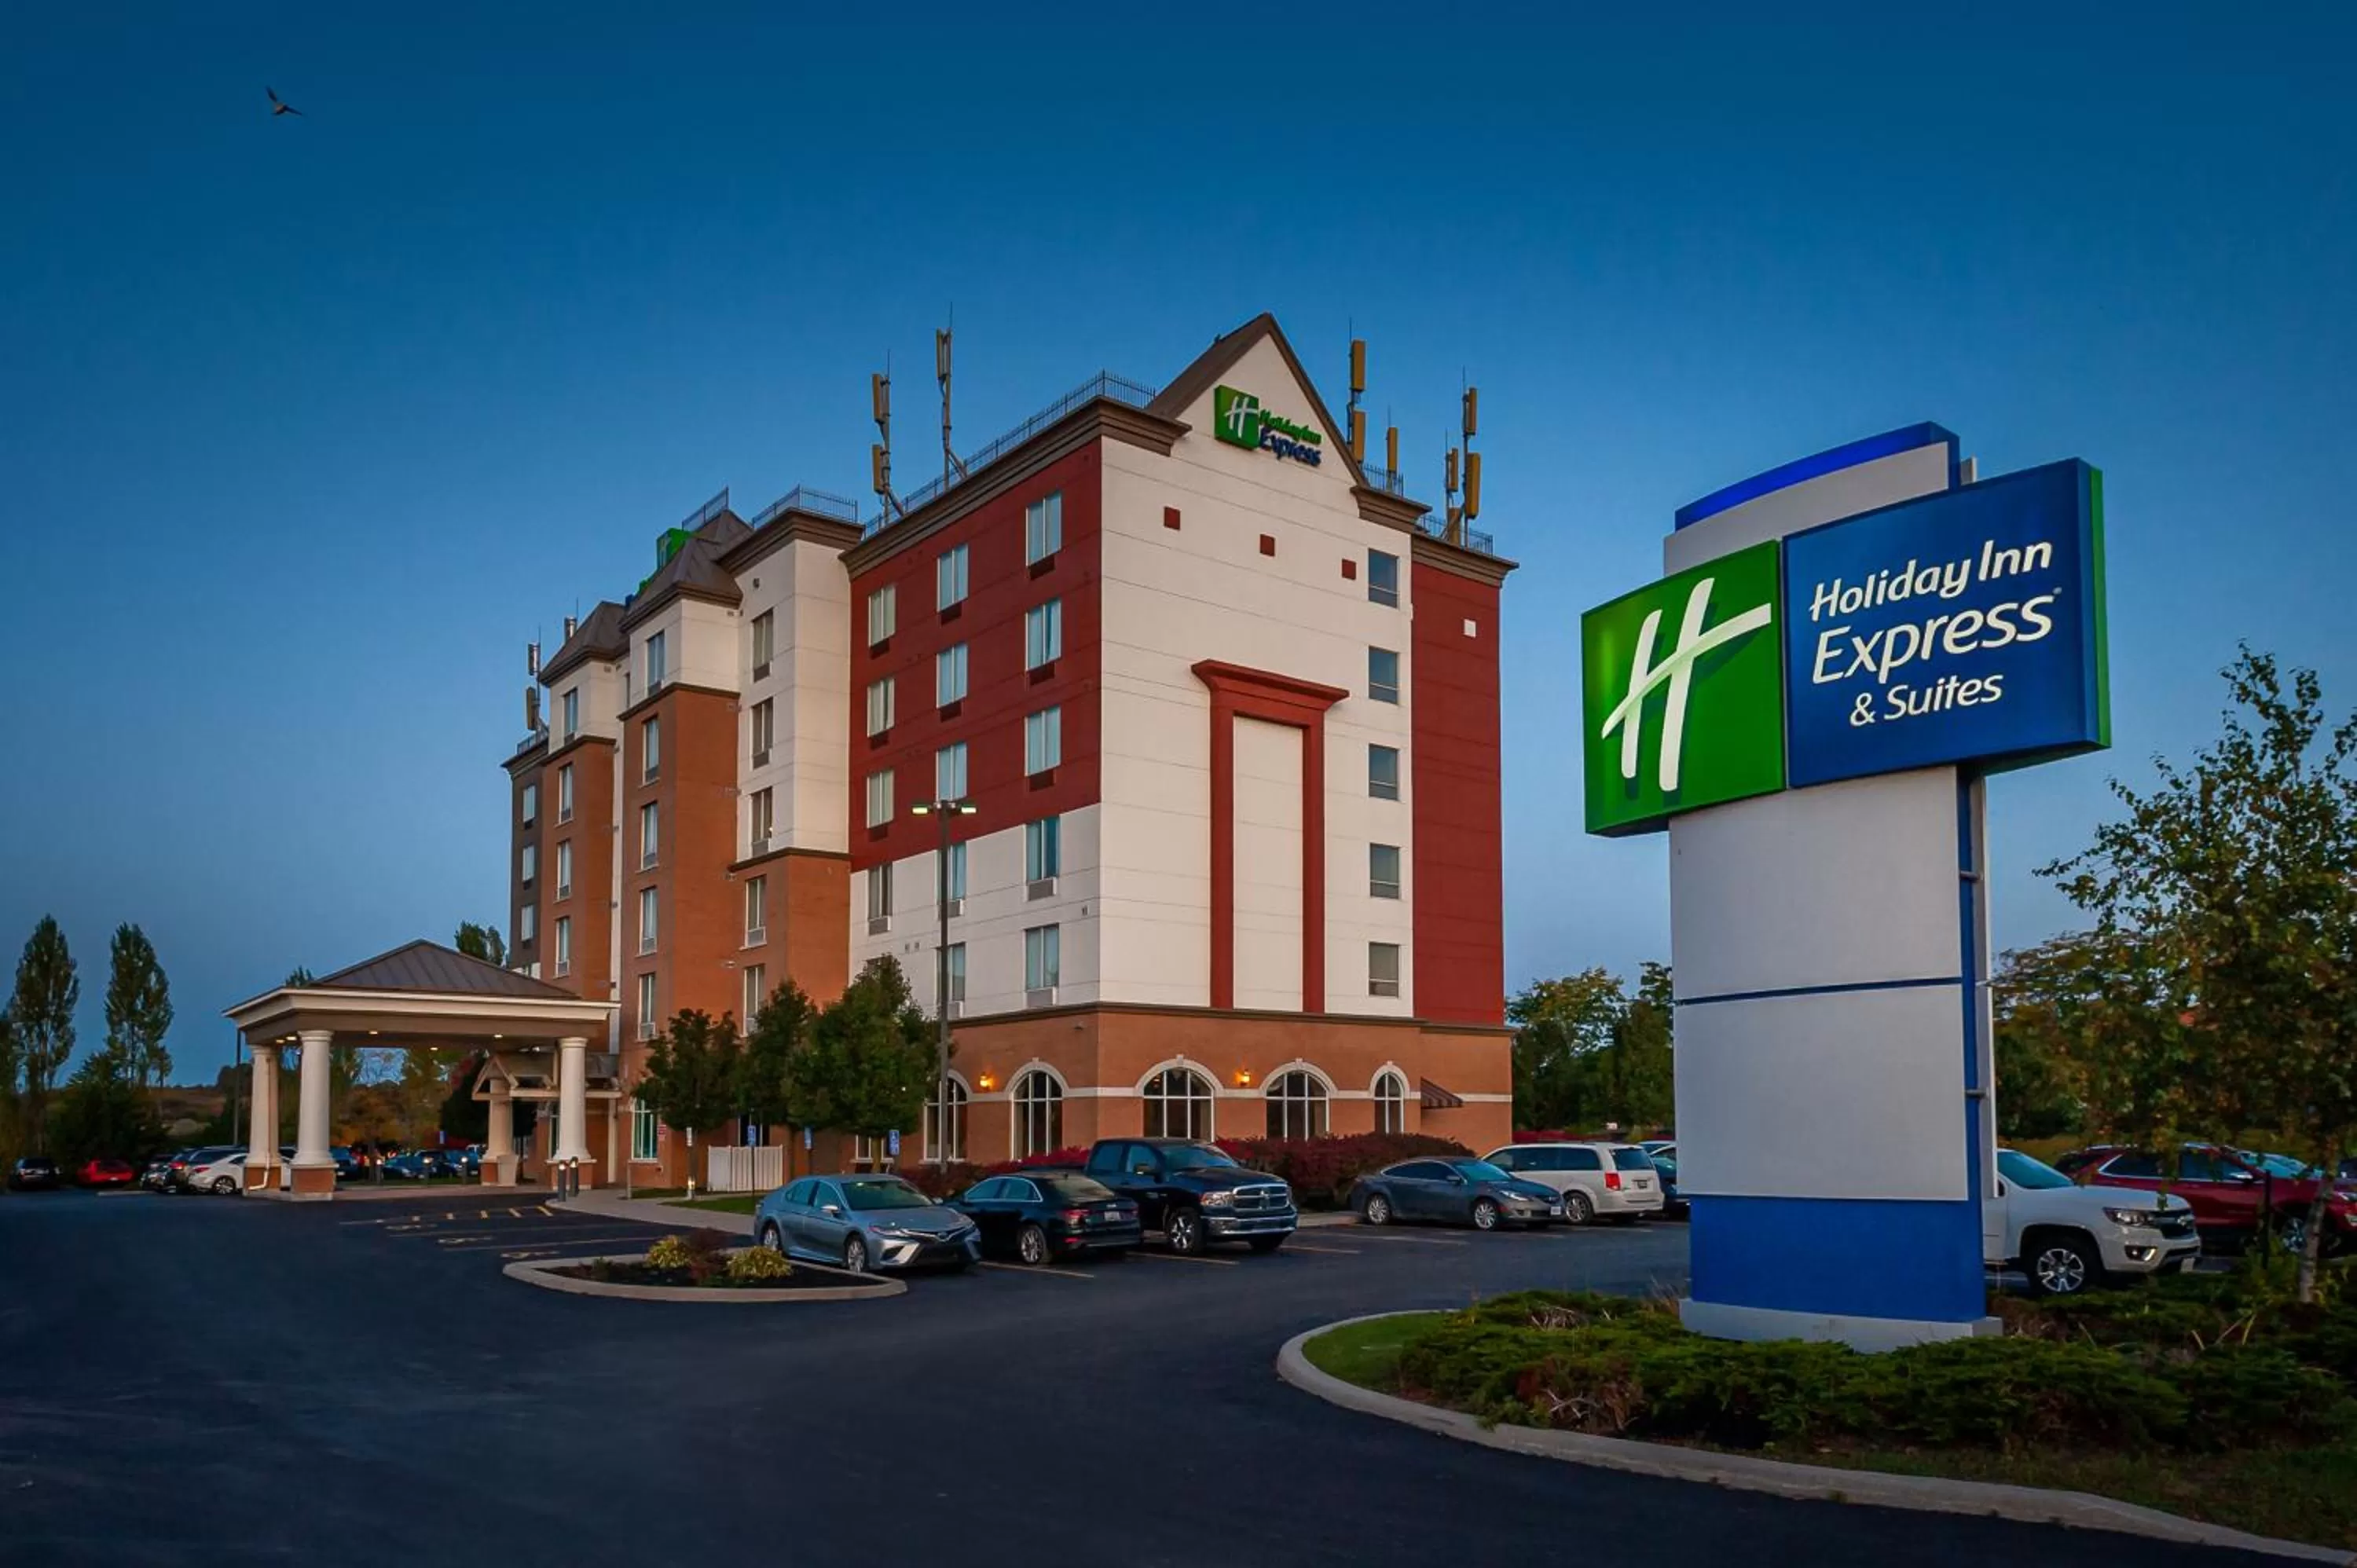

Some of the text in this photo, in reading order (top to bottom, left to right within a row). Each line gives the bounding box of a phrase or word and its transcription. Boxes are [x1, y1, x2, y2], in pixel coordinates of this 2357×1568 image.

[1259, 427, 1321, 467] Express
[1809, 540, 2053, 621] Holiday Inn
[1813, 595, 2055, 684] Express
[1850, 674, 2003, 727] & Suites
